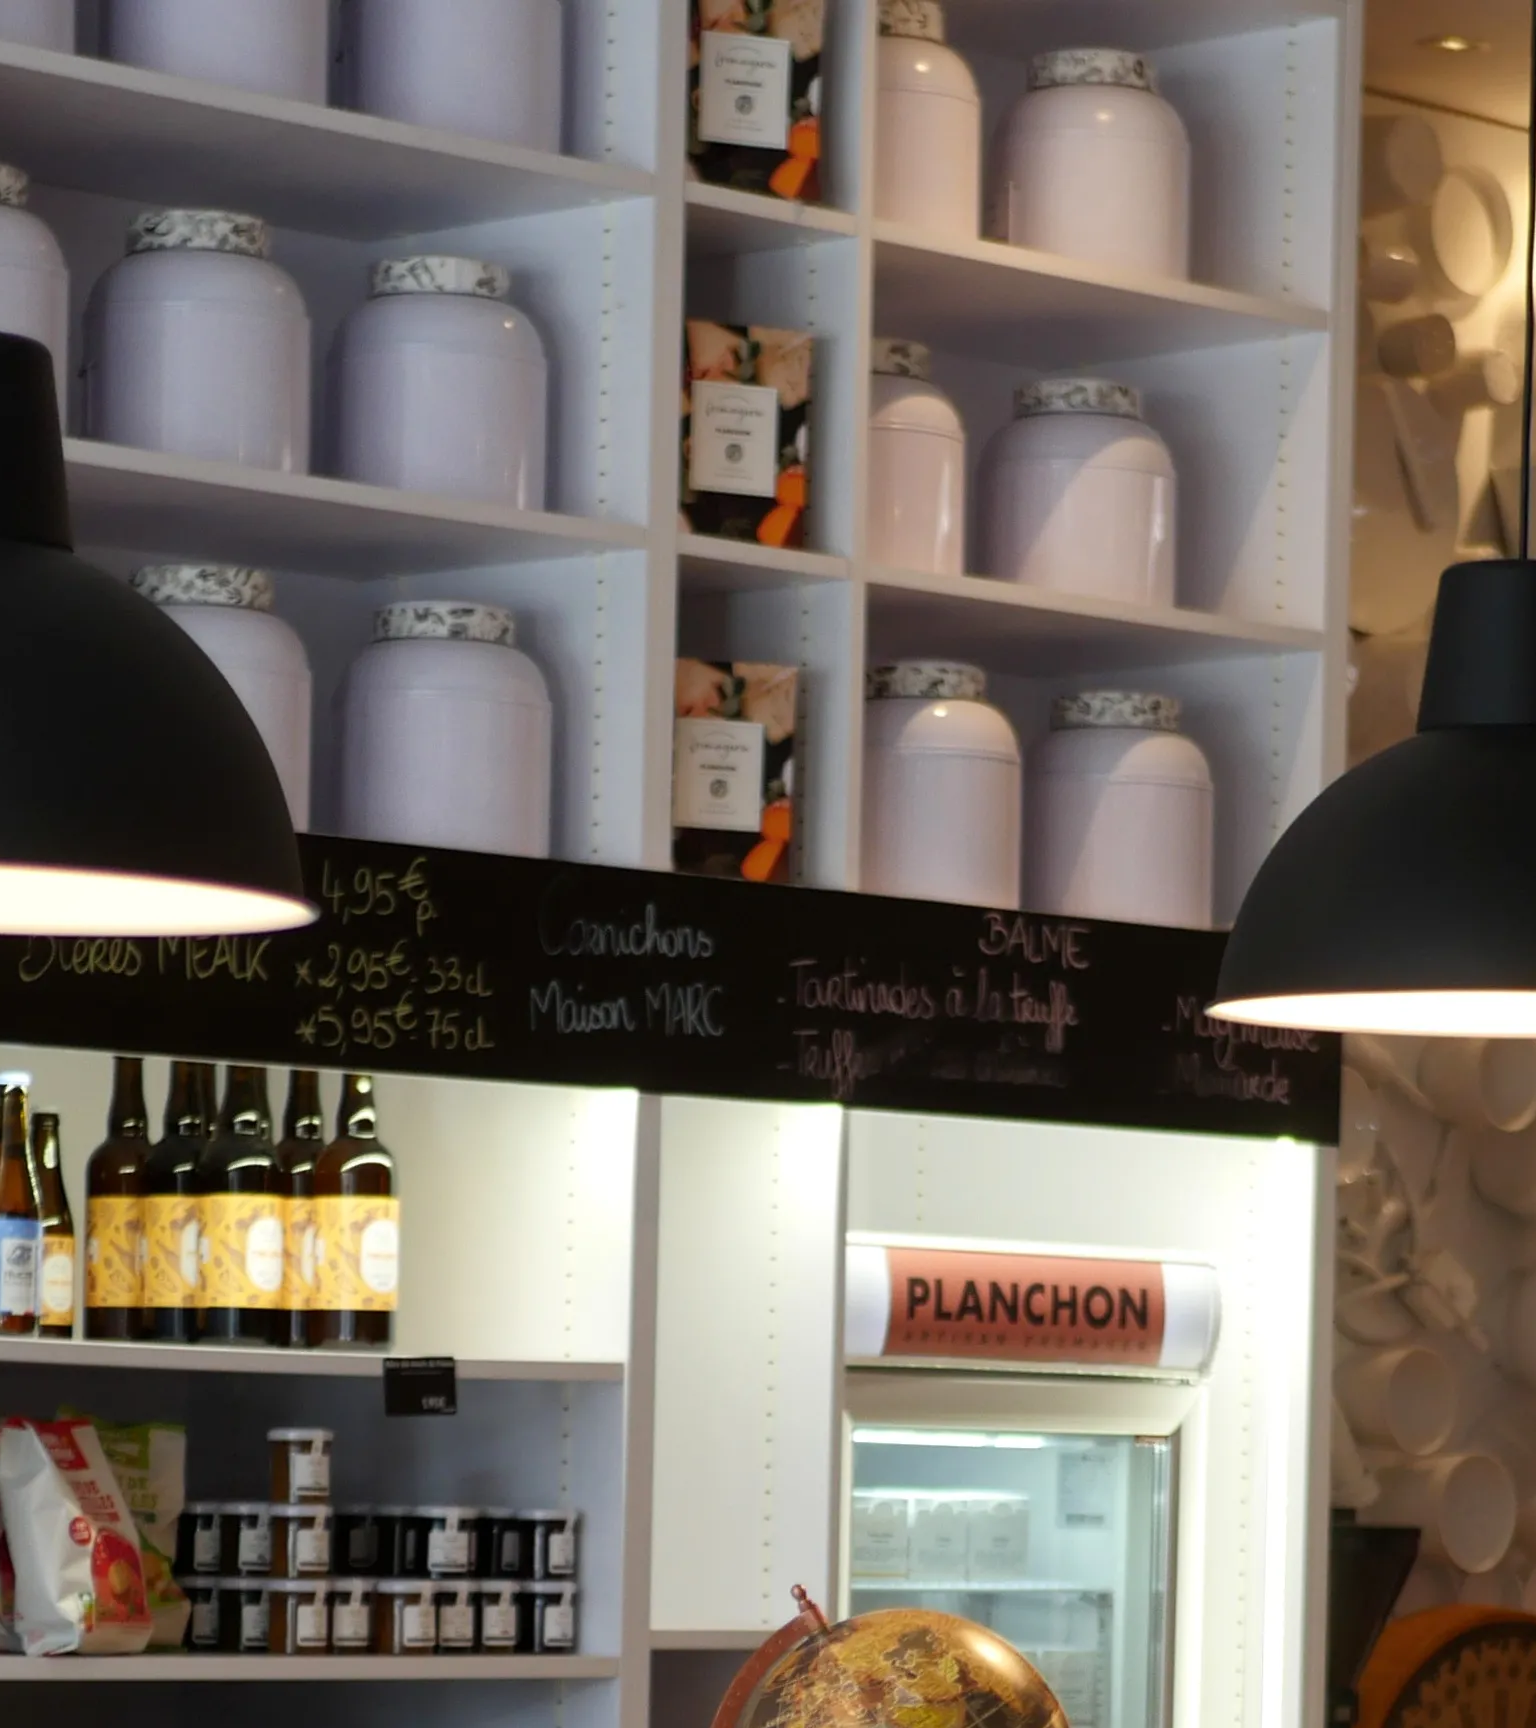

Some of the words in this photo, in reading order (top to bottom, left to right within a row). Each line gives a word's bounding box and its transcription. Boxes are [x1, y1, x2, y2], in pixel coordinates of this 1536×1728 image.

[321, 856, 429, 926] 4,95€
[529, 979, 635, 1033] Maison
[906, 1276, 1150, 1330] PLANCHON
